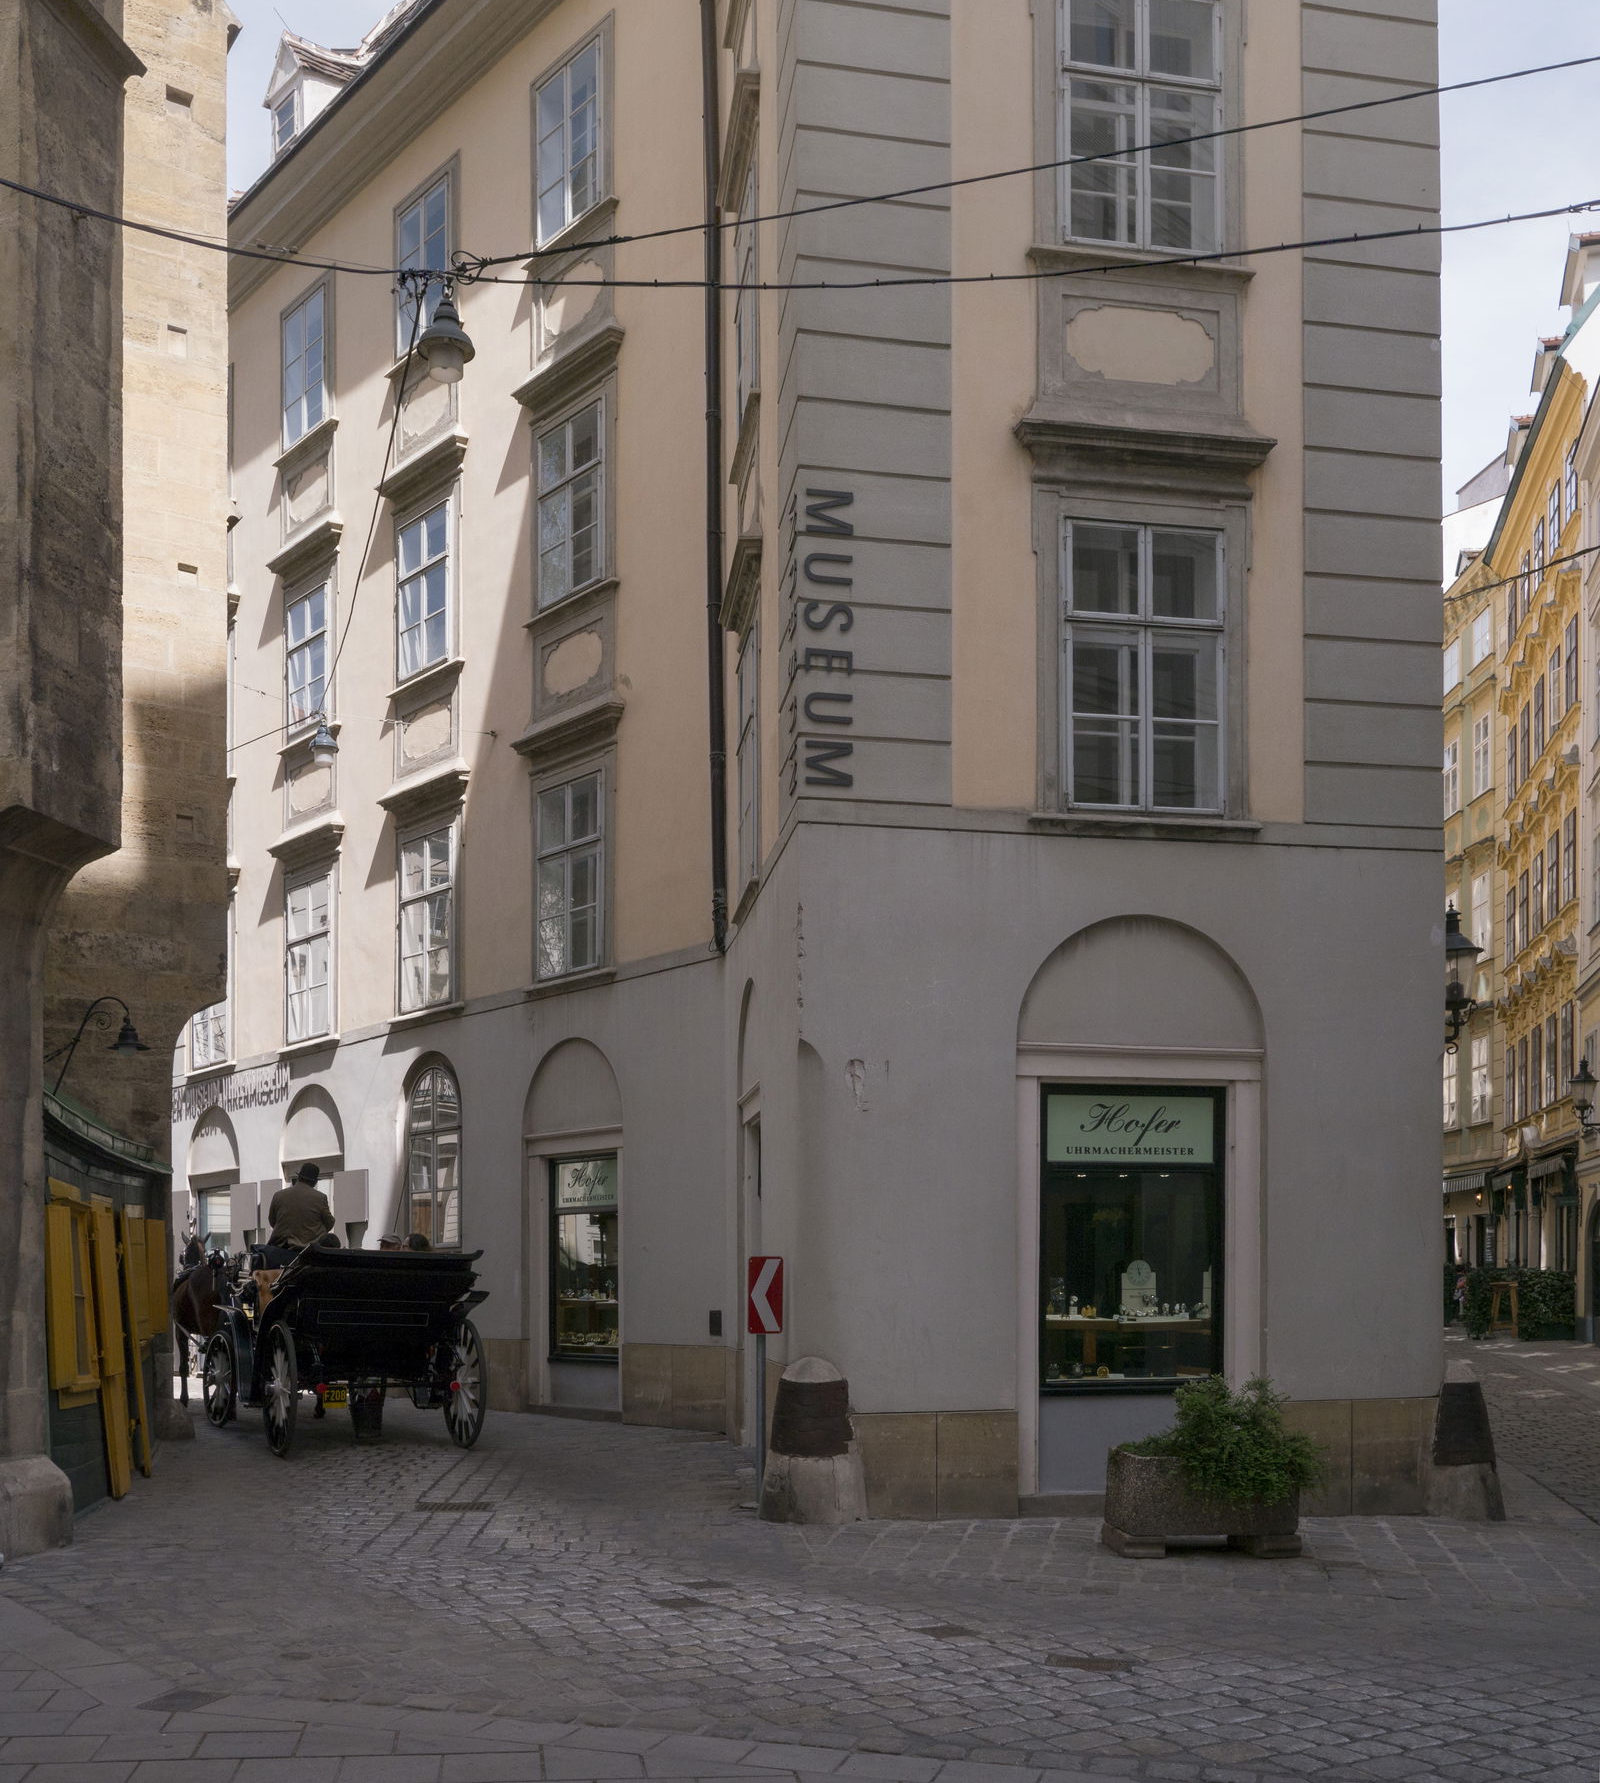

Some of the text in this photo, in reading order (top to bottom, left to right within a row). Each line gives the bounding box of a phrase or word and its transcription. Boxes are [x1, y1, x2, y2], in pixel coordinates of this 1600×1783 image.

[804, 488, 854, 786] MUSEUM
[1080, 1103, 1181, 1146] Hofer
[1066, 1146, 1195, 1155] UHRMACHERMEISTER
[568, 1168, 609, 1195] Hofer
